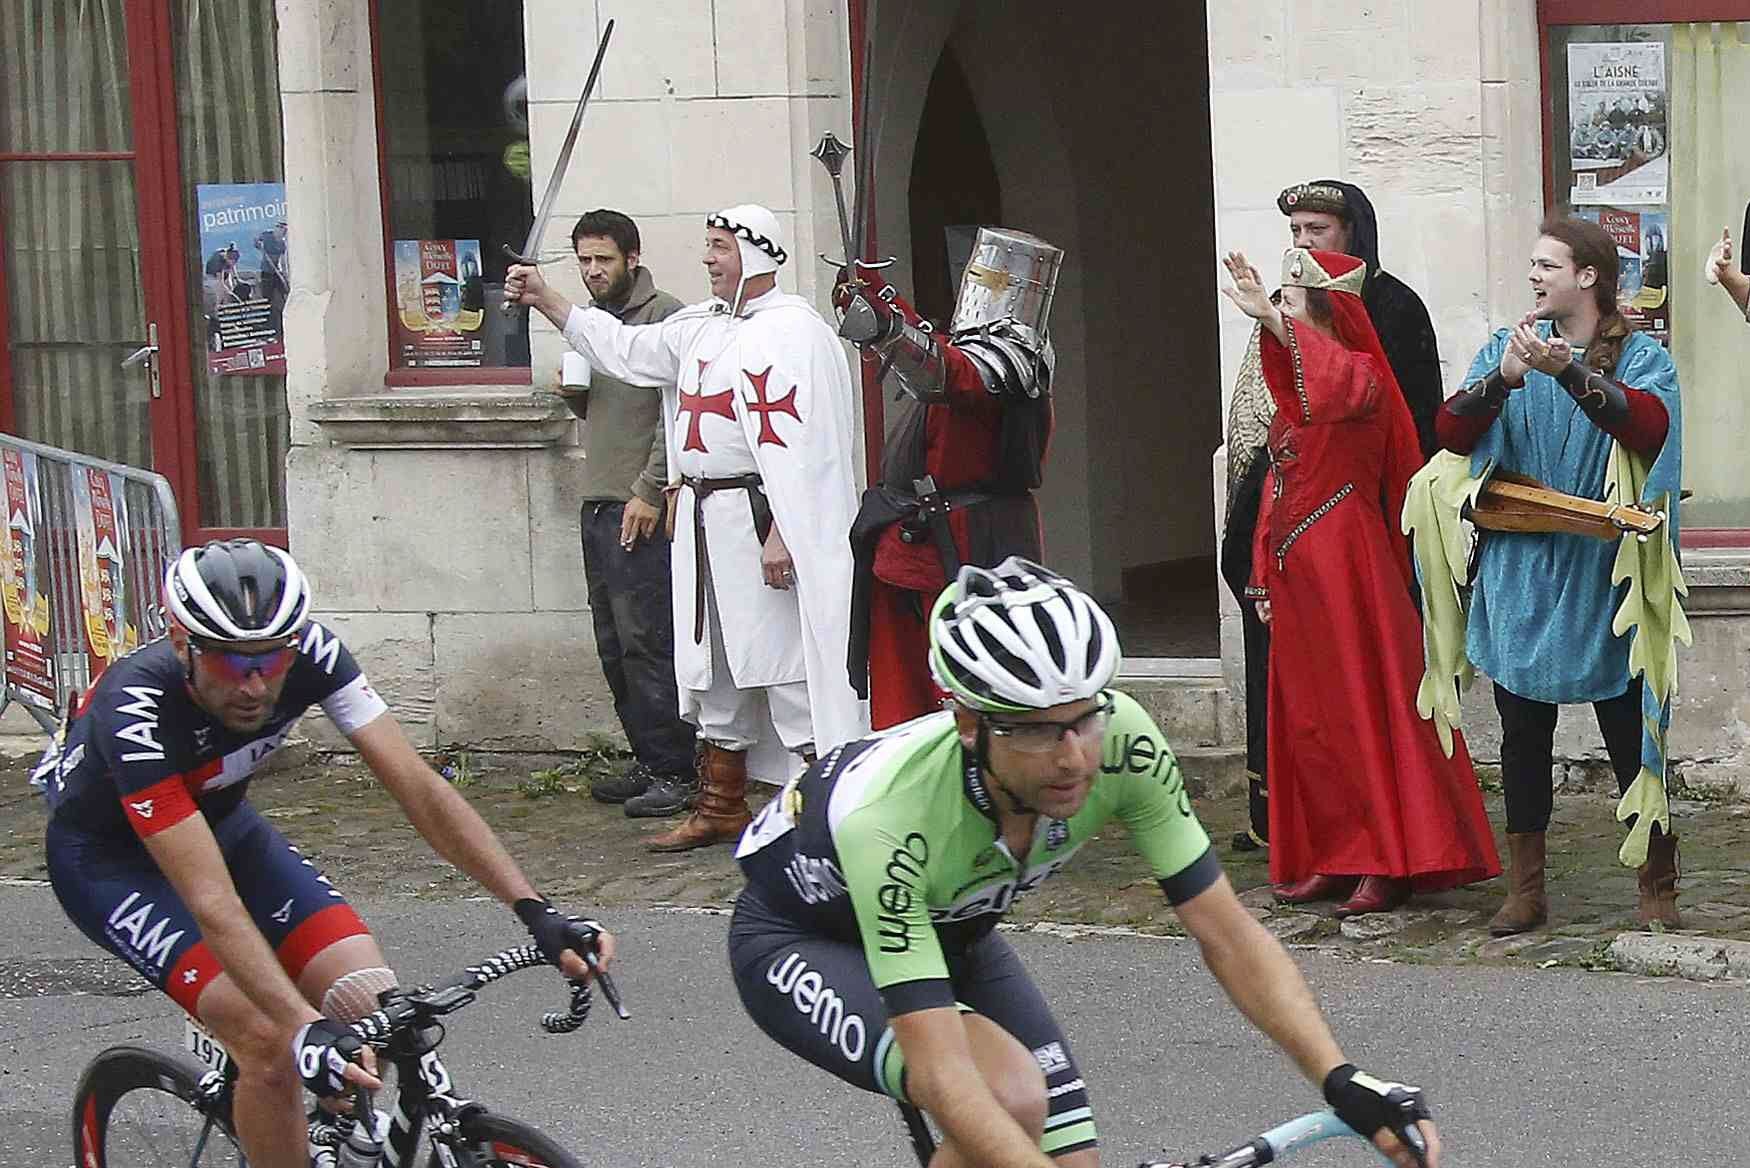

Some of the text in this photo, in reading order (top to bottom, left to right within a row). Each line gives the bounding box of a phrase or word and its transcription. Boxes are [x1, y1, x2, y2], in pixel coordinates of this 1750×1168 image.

[115, 686, 166, 762] IAM
[108, 892, 185, 968] IAM
[877, 832, 929, 954] wemo
[766, 952, 867, 1063] wemo
[193, 1030, 224, 1071] 197
